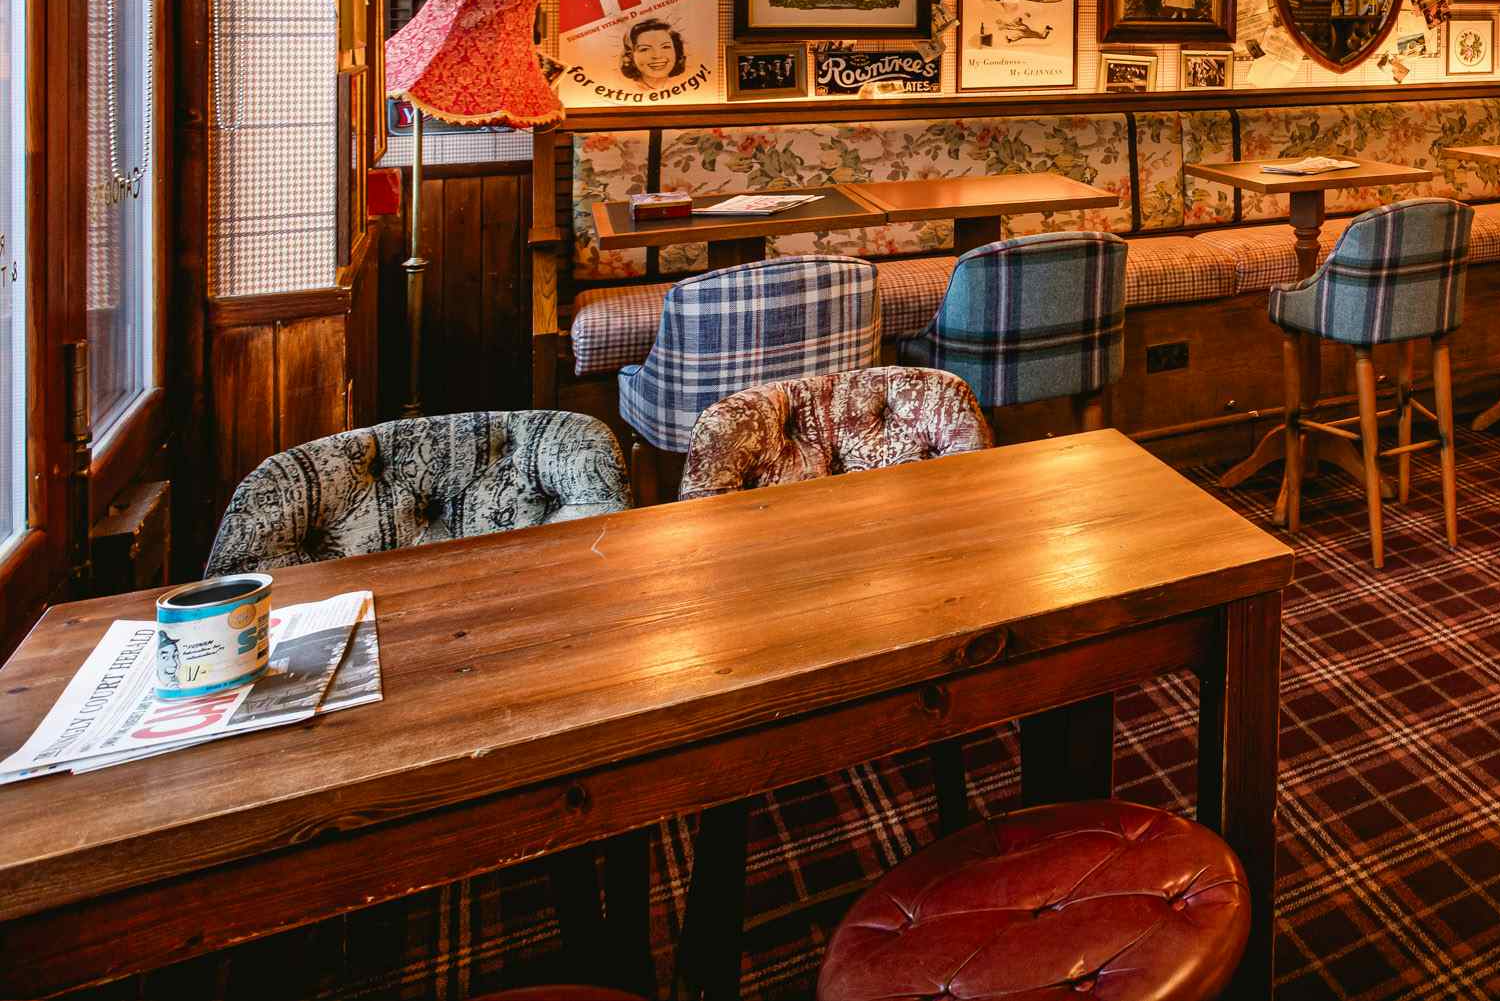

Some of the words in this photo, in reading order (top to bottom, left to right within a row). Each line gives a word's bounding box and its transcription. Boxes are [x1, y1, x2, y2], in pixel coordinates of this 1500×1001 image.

[567, 65, 595, 87] for
[594, 84, 645, 103] extra
[649, 63, 712, 102] energy!
[111, 628, 157, 670] HERALD
